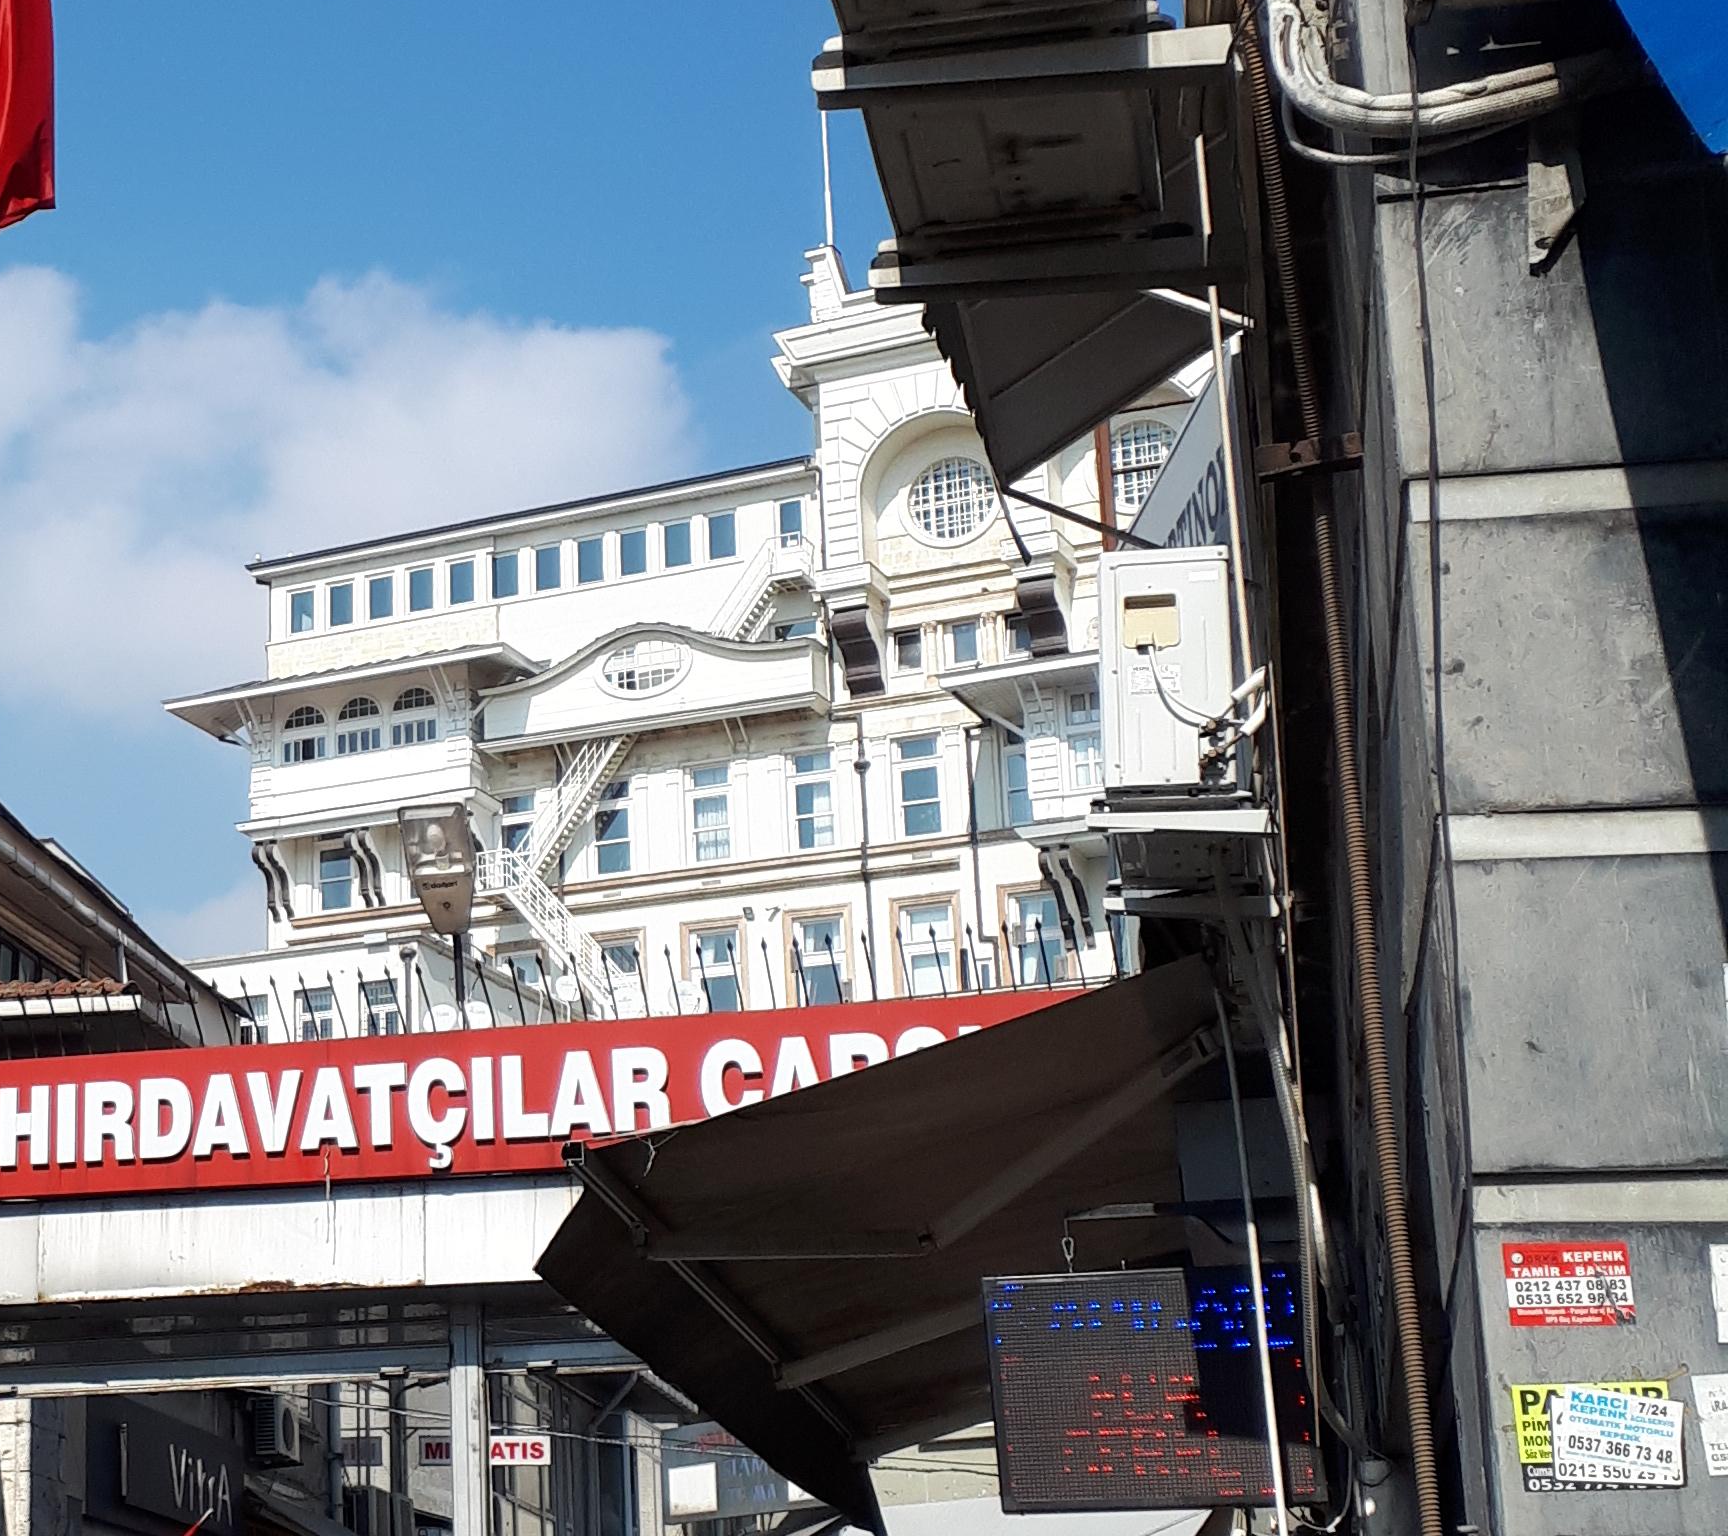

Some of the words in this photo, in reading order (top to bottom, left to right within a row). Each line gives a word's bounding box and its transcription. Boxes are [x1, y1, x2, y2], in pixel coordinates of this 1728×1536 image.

[1562, 1250, 1624, 1263] KEPENK
[1511, 1264, 1561, 1277] TAMİR
[1515, 1280, 1551, 1292] 0212
[1555, 1279, 1581, 1291] 437
[1516, 1293, 1552, 1305] 0533
[1557, 1293, 1583, 1304] 652
[1569, 1403, 1628, 1421] KEPENK
[1638, 1402, 1668, 1417] 7/24
[1522, 1417, 1551, 1432] PİM
[1523, 1435, 1552, 1447] MON
[1568, 1434, 1602, 1453] 0537
[1605, 1440, 1631, 1458] 366
[1635, 1445, 1652, 1461] 73
[1656, 1449, 1673, 1464] 48
[169, 1443, 232, 1527] VitrA
